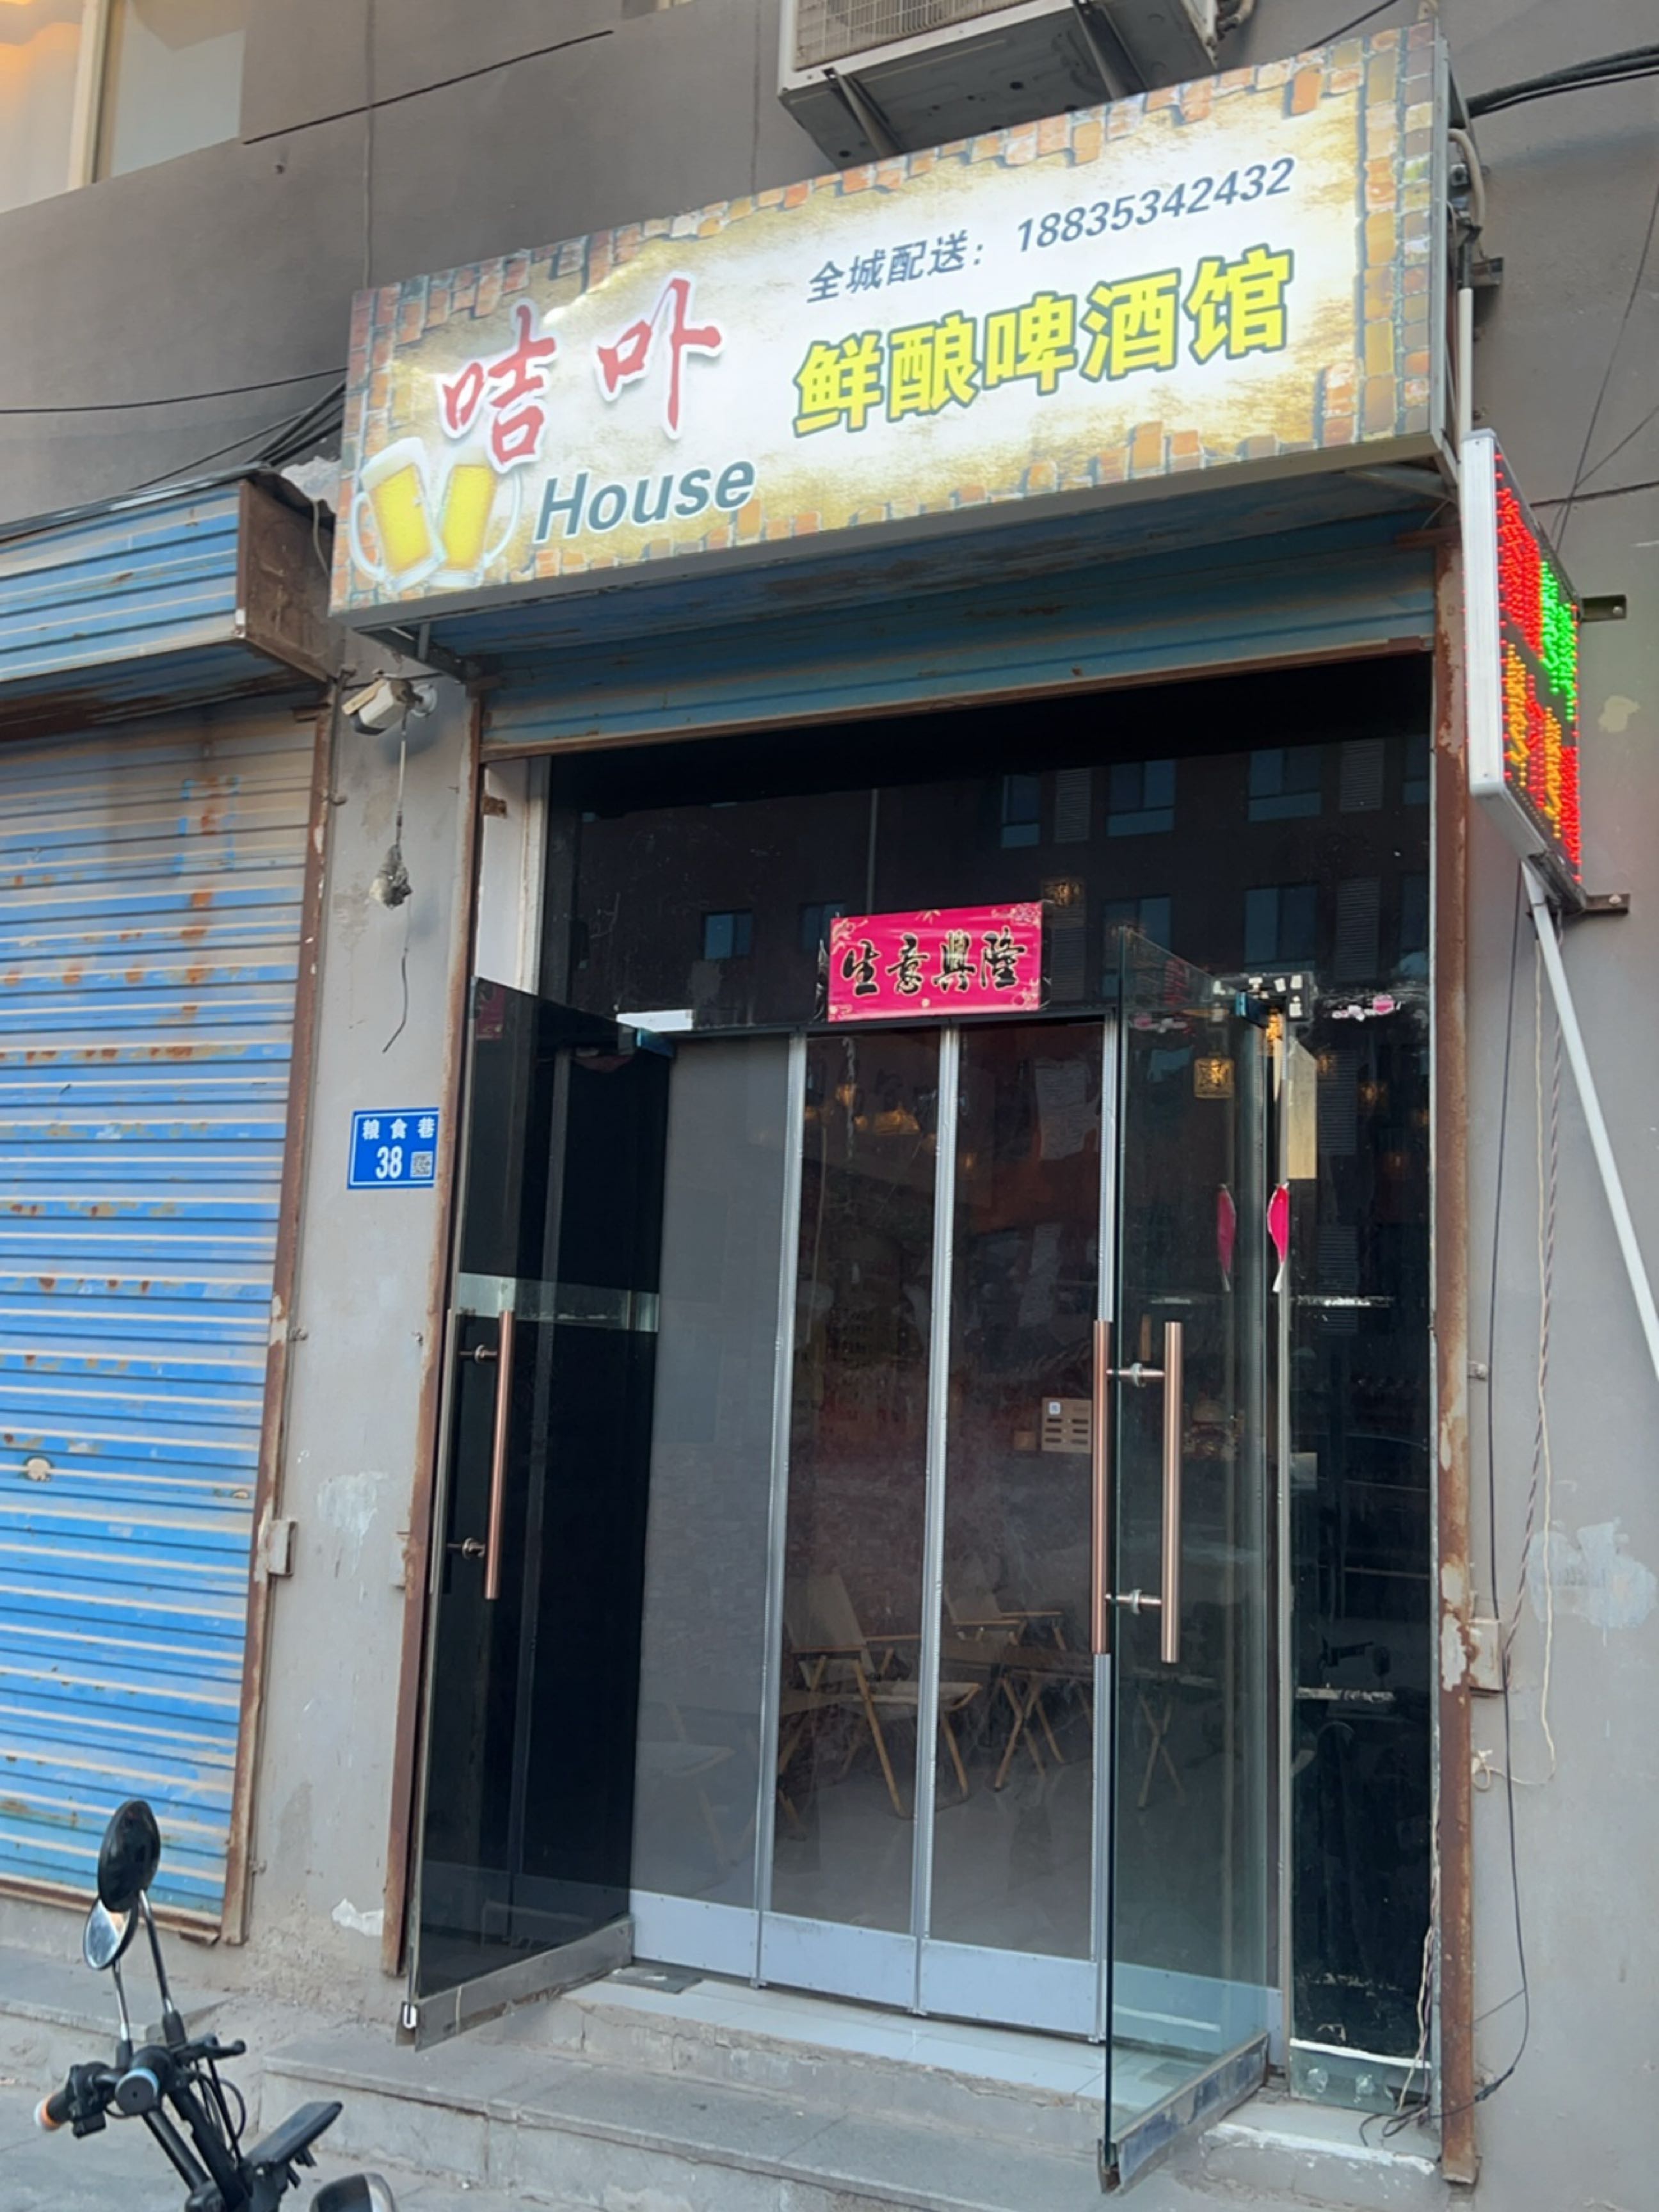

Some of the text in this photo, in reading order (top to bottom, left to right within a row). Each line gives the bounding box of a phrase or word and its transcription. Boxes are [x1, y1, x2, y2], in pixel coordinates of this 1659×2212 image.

[1018, 157, 1295, 252] 18835342432
[792, 243, 1294, 438] 鲜酿啤酒馆
[536, 459, 755, 541] House
[376, 1146, 403, 1179] 38
